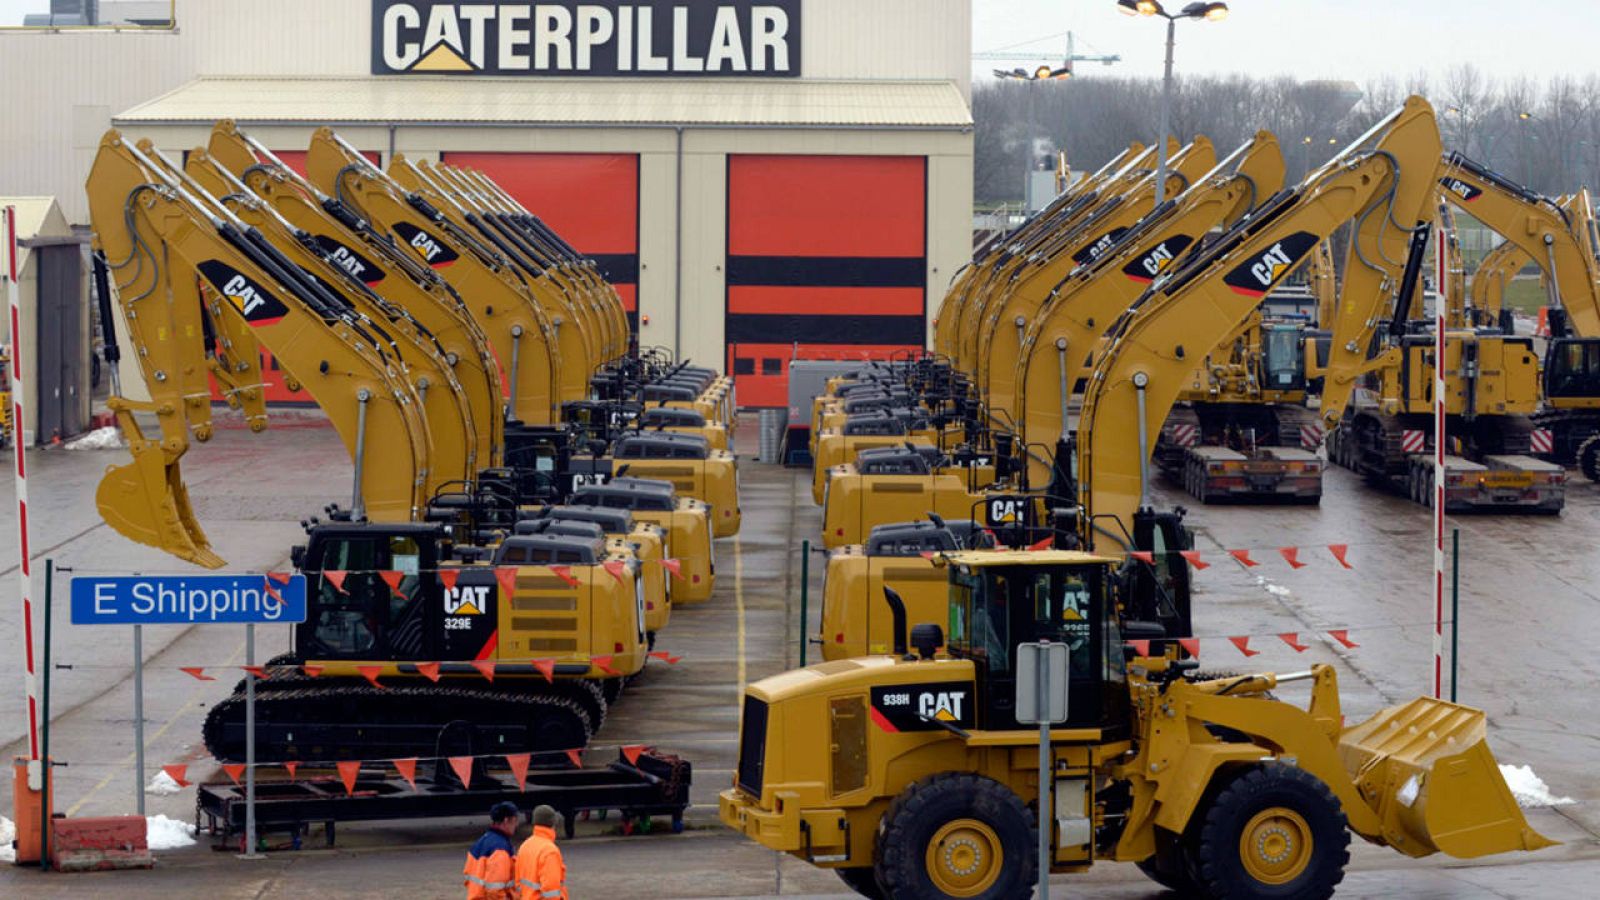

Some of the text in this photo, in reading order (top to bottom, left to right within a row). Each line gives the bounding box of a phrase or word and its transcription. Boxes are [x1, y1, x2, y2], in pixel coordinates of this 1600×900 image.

[382, 3, 790, 72] CATERPILLAR
[410, 231, 443, 260] CAT
[1142, 242, 1174, 275] CAT
[334, 246, 366, 277] CAT
[1251, 242, 1293, 286] CAT
[223, 275, 265, 316] CAT
[991, 500, 1024, 521] CAT
[94, 581, 282, 620] E Shipping
[444, 586, 490, 615] CAT
[444, 618, 471, 630] 329E
[883, 691, 966, 722] 938H CAT
